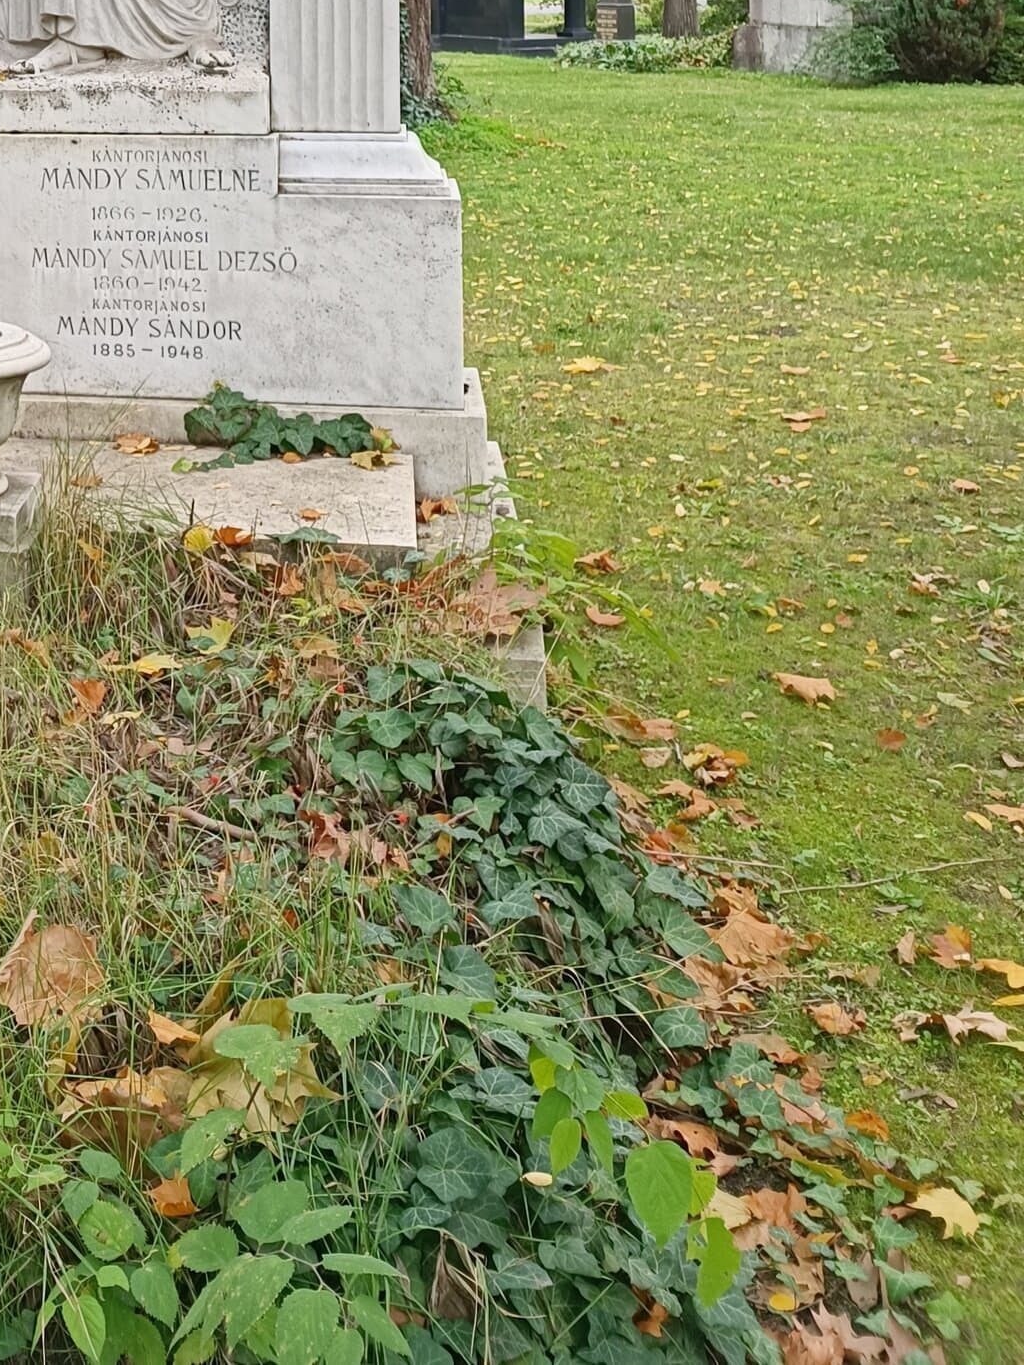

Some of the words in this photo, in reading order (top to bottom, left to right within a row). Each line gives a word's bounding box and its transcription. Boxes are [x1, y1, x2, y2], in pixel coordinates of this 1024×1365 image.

[92, 146, 209, 165] KÁNTORJÁNOSI
[40, 162, 128, 191] MÁNDY
[135, 163, 261, 192] SÁMUELNÉ
[93, 226, 209, 245] KÁNTORJÁNOSI
[31, 242, 112, 269] MÁNDY
[120, 242, 209, 271] SÁMUEL
[92, 294, 206, 315] KÁNTORJÁNOSI
[57, 310, 139, 338] MÁNDY
[148, 313, 243, 341] SÁNDOR
